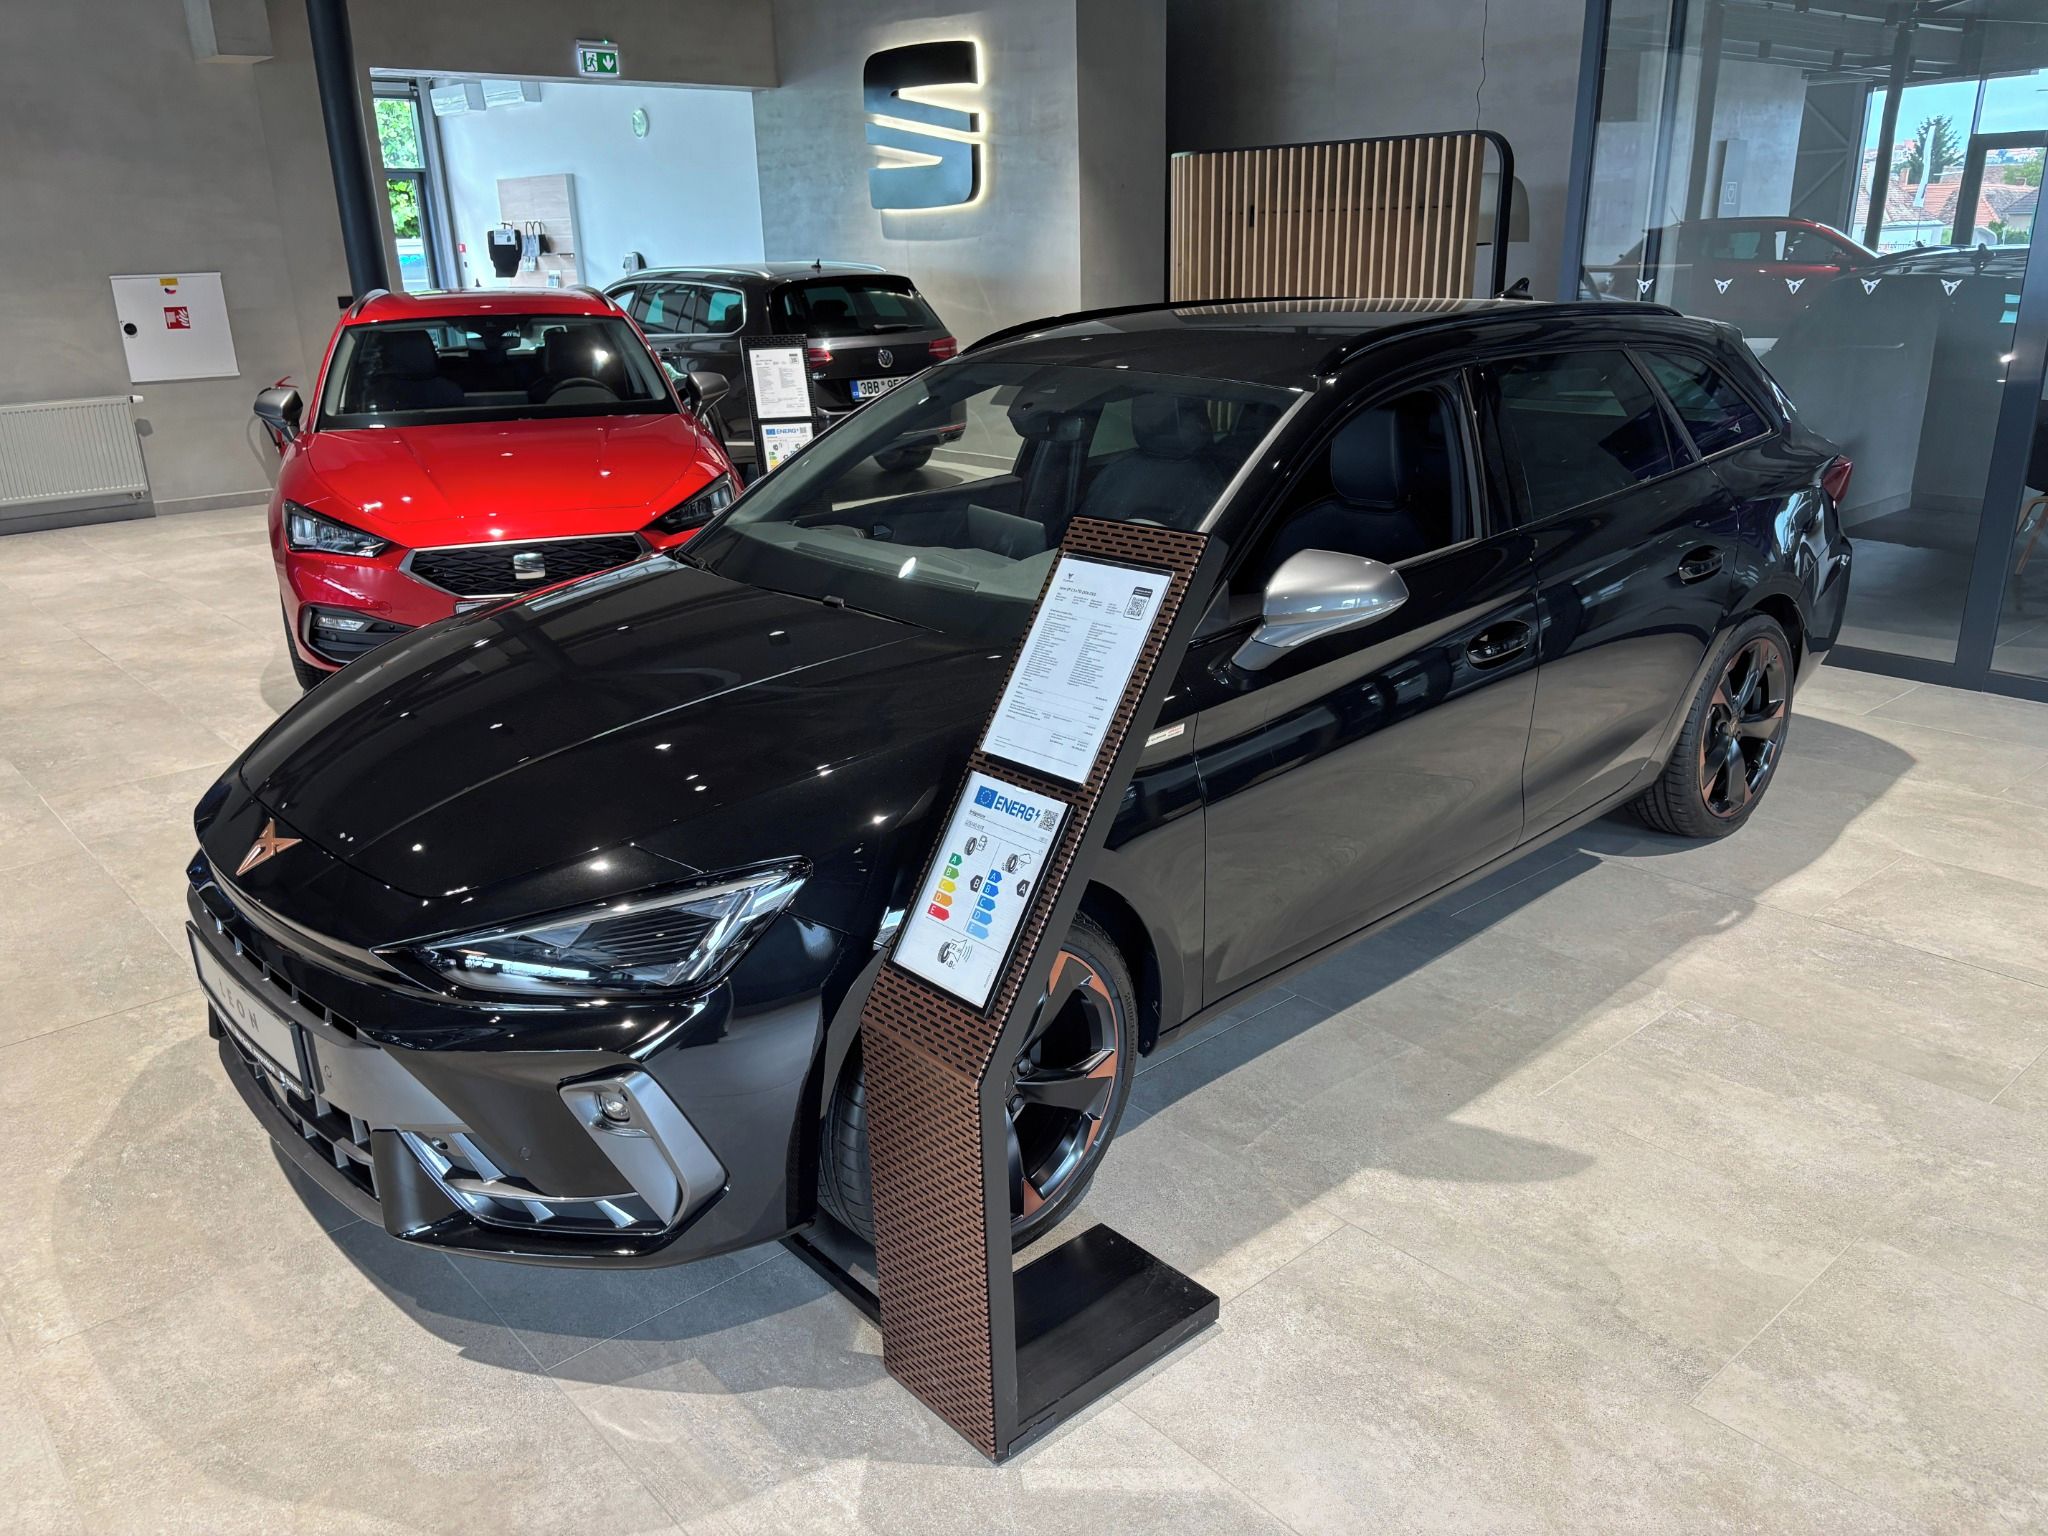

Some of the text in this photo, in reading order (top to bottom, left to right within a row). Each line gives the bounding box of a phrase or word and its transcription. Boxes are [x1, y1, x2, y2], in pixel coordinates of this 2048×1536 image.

[860, 381, 880, 395] 3BB
[993, 795, 1035, 822] ENERG
[218, 977, 260, 1033] LEON
